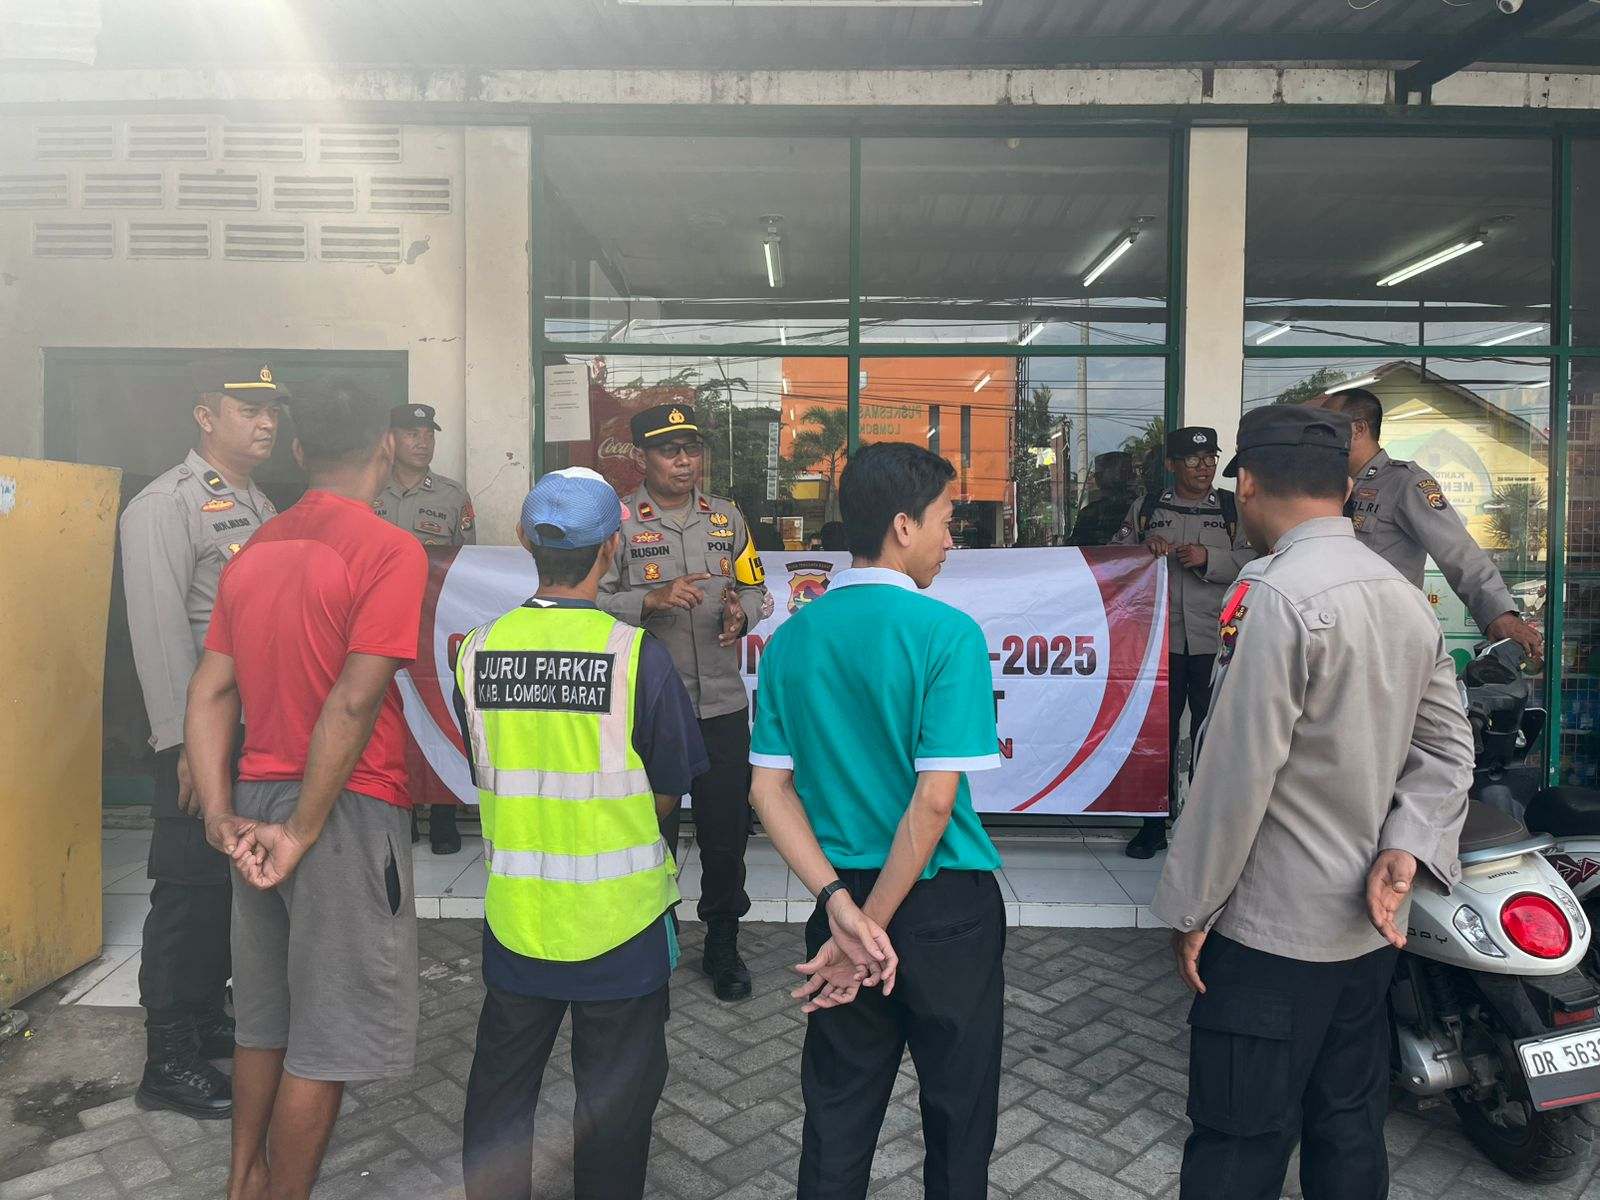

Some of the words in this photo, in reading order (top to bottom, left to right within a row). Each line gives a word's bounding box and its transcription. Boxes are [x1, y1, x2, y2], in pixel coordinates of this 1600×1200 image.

[418, 508, 447, 520] POLRI
[630, 545, 670, 559] RUSDIN
[479, 657, 527, 680] JURU
[535, 657, 609, 683] PARKIR
[478, 684, 501, 702] KAB.
[505, 684, 556, 703] LOMBOK
[561, 685, 606, 706] BARAT
[1487, 870, 1519, 880] HONDA
[1532, 1050, 1558, 1075] DR
[1562, 1038, 1600, 1068] 563
